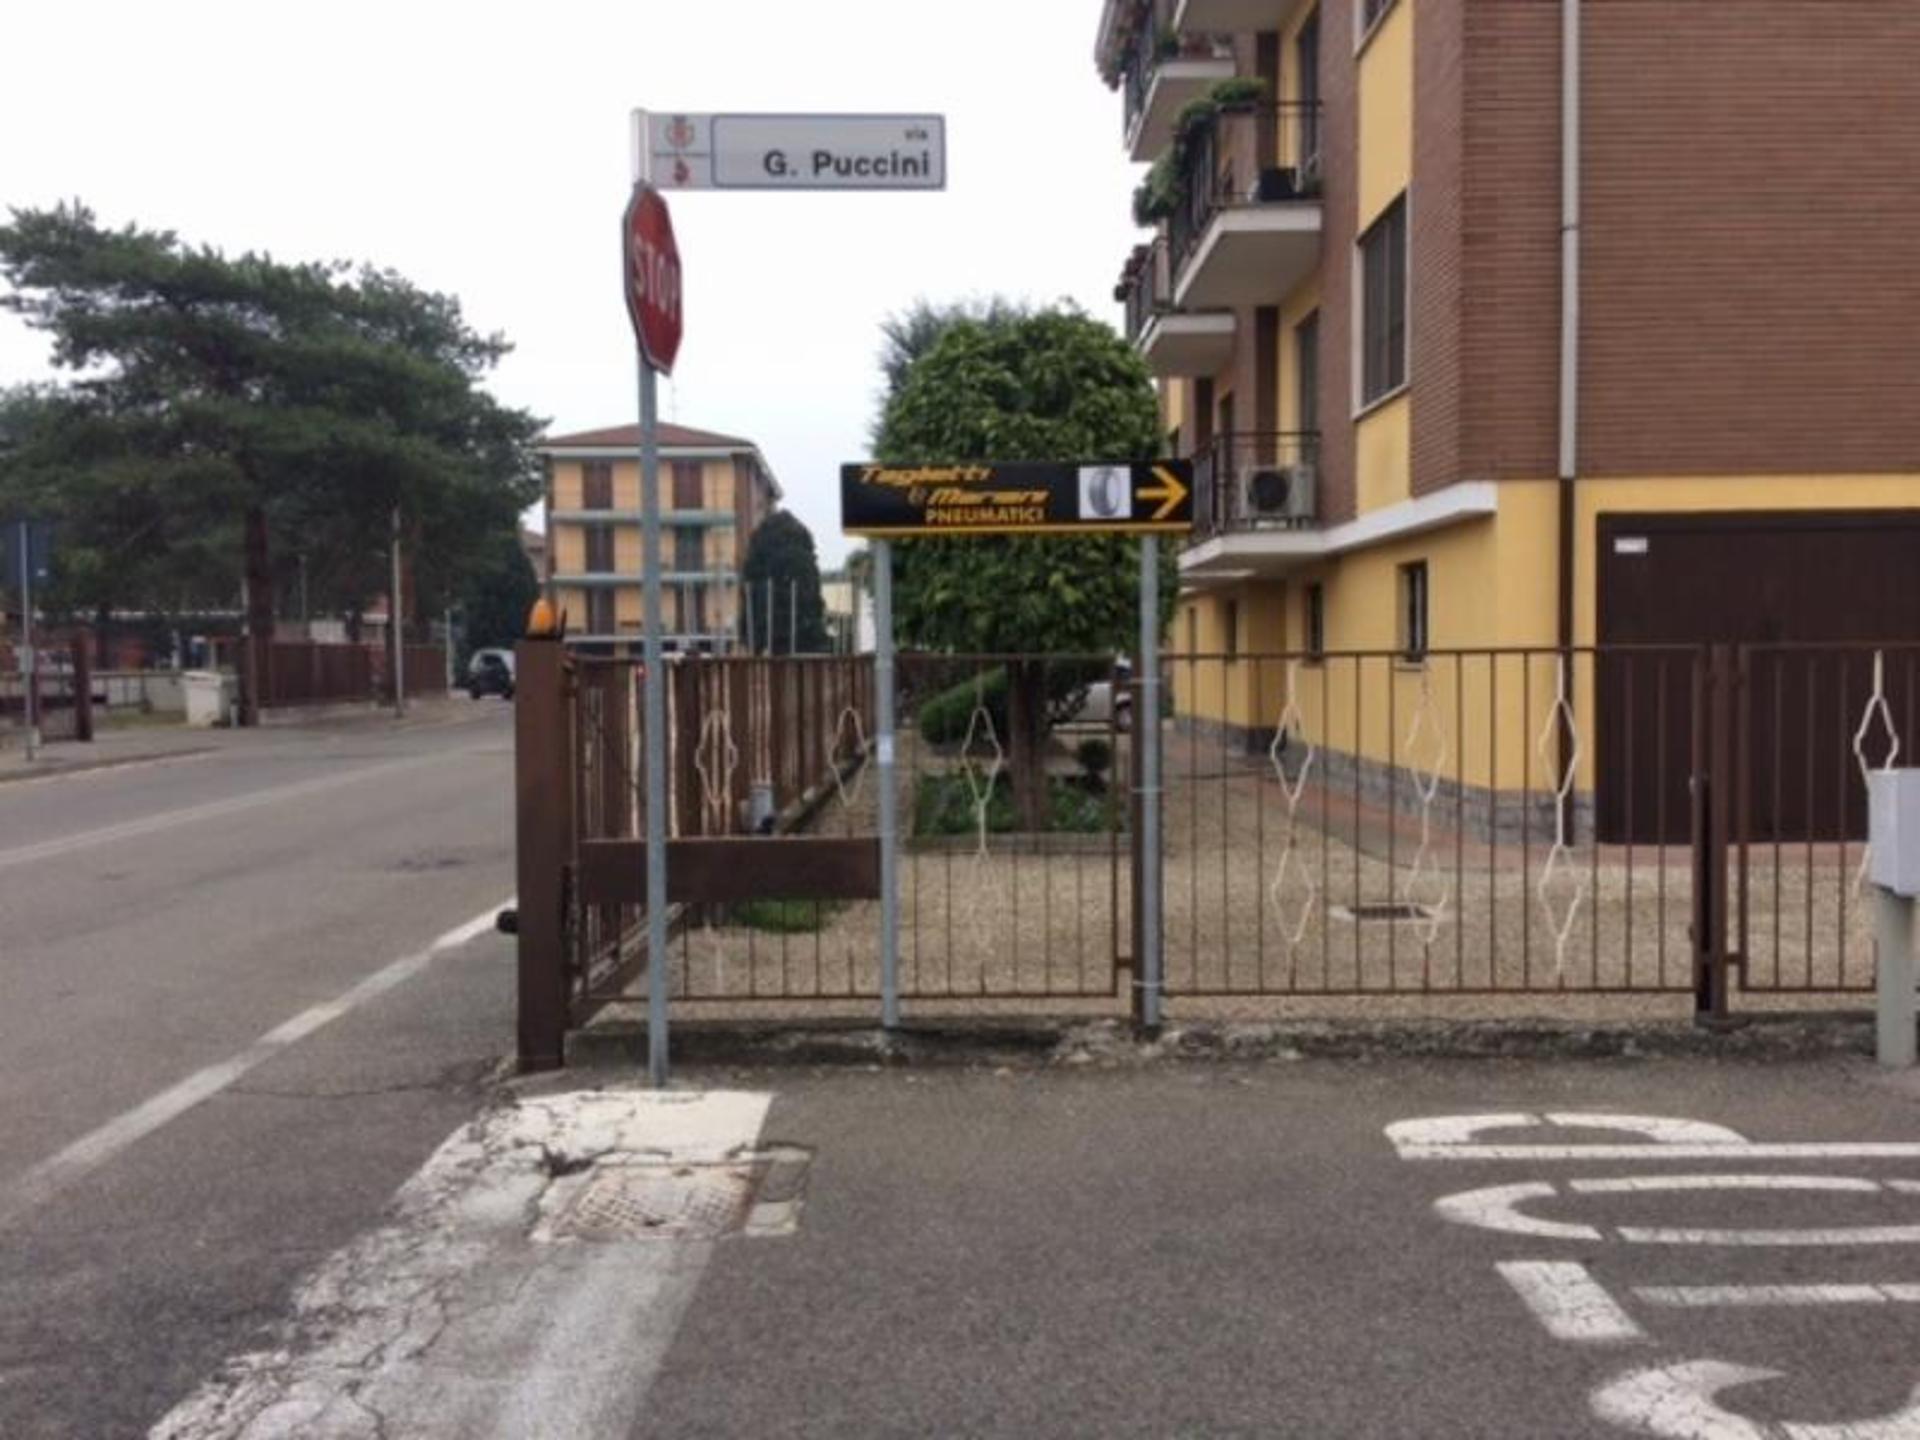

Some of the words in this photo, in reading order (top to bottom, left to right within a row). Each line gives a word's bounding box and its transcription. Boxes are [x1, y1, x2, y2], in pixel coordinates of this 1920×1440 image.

[904, 129, 928, 141] via
[763, 150, 798, 177] G.
[813, 150, 930, 177] Puccini
[633, 232, 678, 321] STOP
[926, 507, 1044, 522] PNEUMATICI
